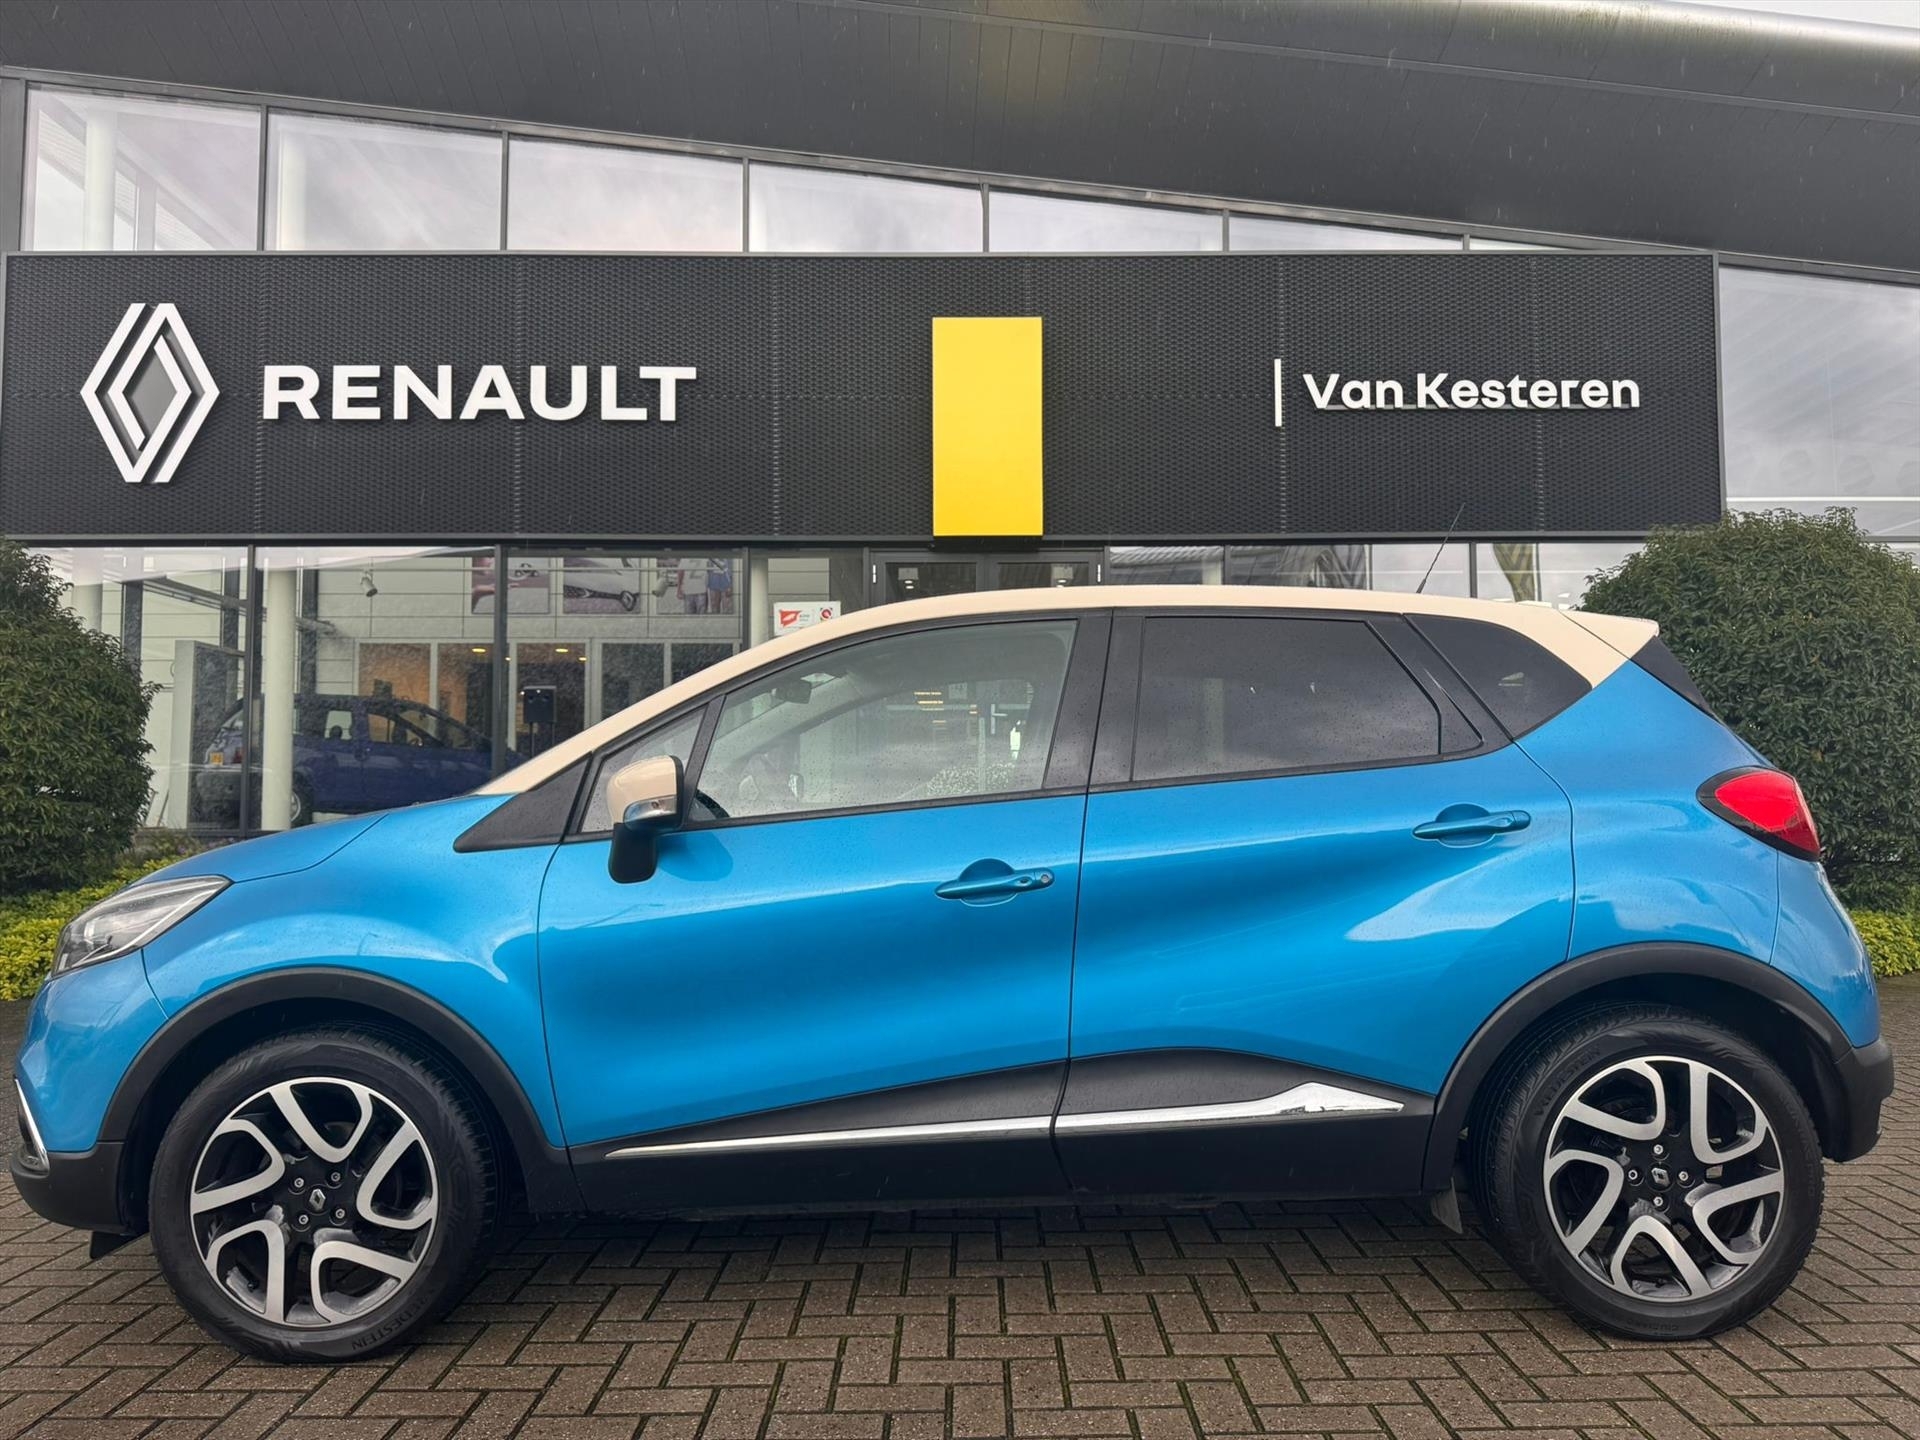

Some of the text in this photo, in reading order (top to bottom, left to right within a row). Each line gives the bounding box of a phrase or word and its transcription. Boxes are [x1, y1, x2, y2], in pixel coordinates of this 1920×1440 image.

[263, 364, 697, 421] RENAULT
[1303, 372, 1640, 409] Van Kesteren
